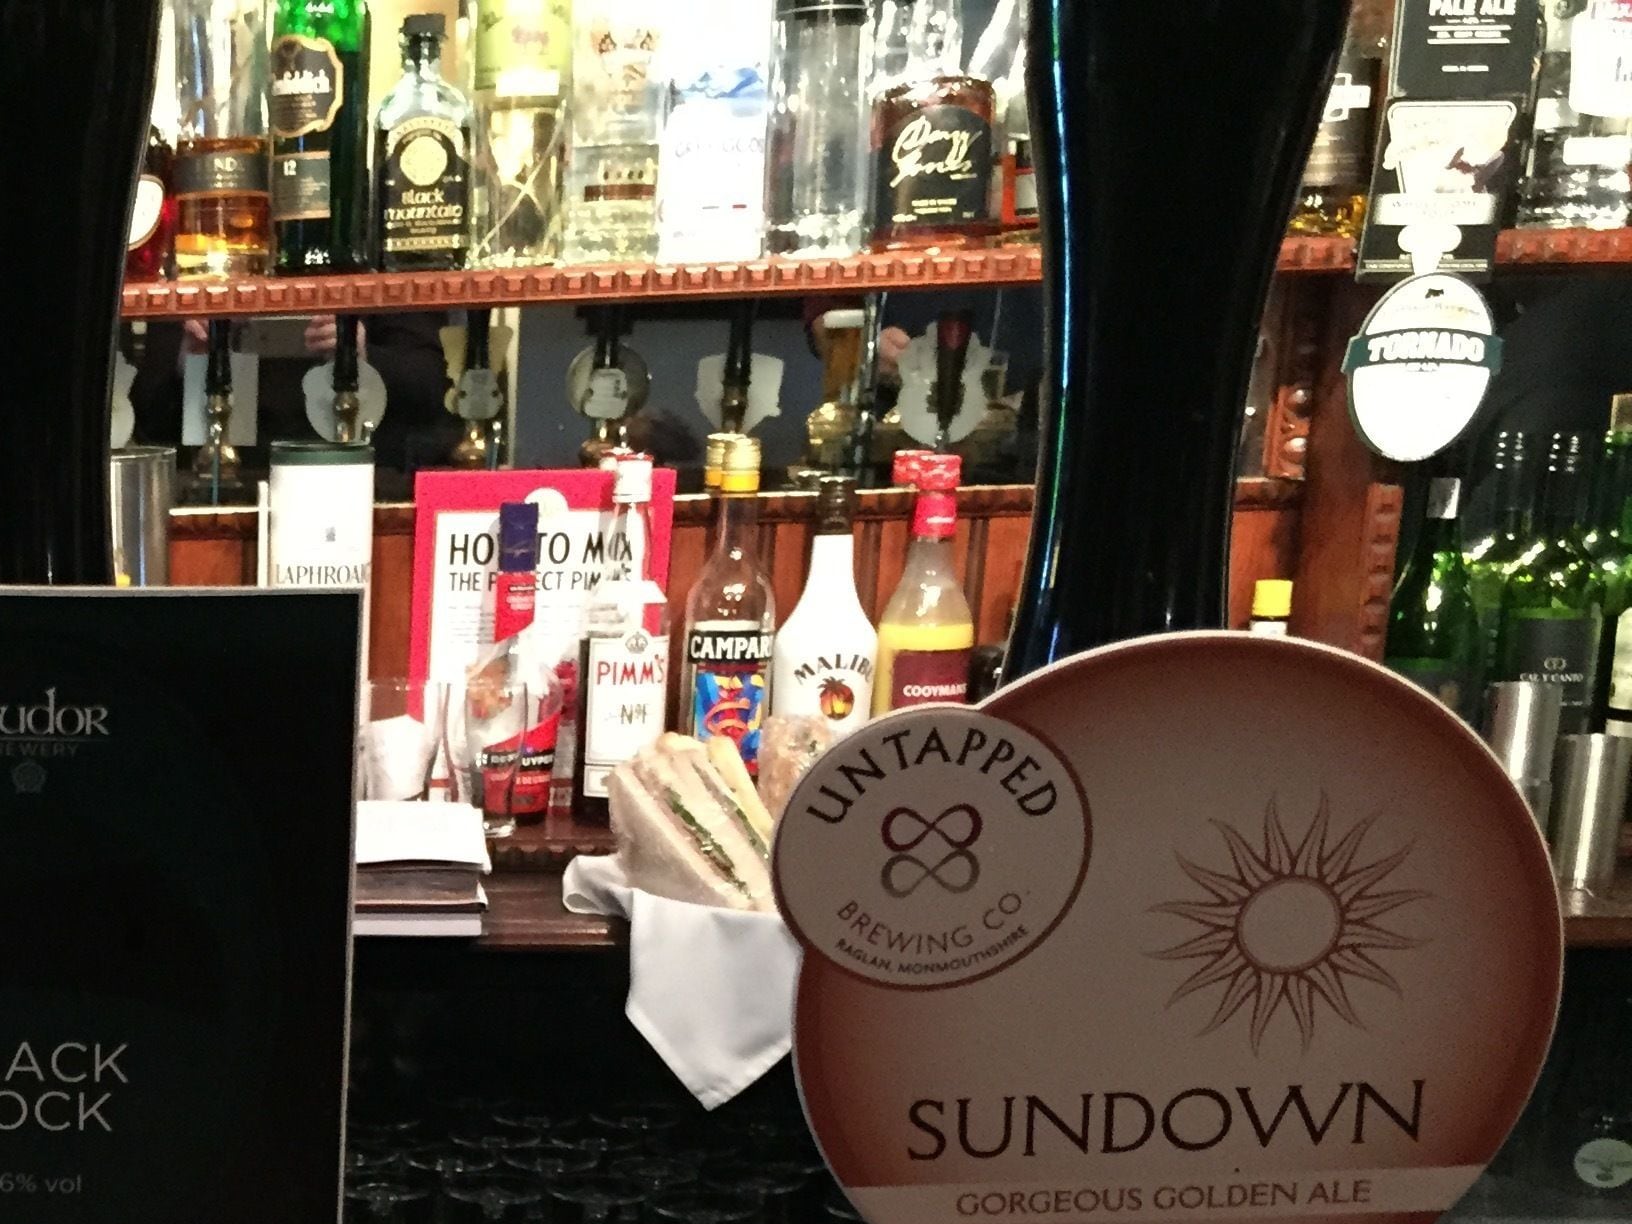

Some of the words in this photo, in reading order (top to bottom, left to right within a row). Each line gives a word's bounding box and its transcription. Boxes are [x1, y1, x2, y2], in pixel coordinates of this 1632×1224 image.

[1367, 330, 1485, 363] TORNADO
[448, 572, 481, 593] THE
[806, 726, 1058, 825] UNTAPPED
[836, 900, 974, 955] BREWING
[896, 924, 1030, 974] MONMOUTHSHIRE
[906, 1079, 1426, 1162] SUNDOWN
[44, 1174, 83, 1194] vol
[955, 1186, 1144, 1216] GORGEOUS
[1152, 1181, 1299, 1209] GOLDEN
[1306, 1178, 1373, 1205] ALE
